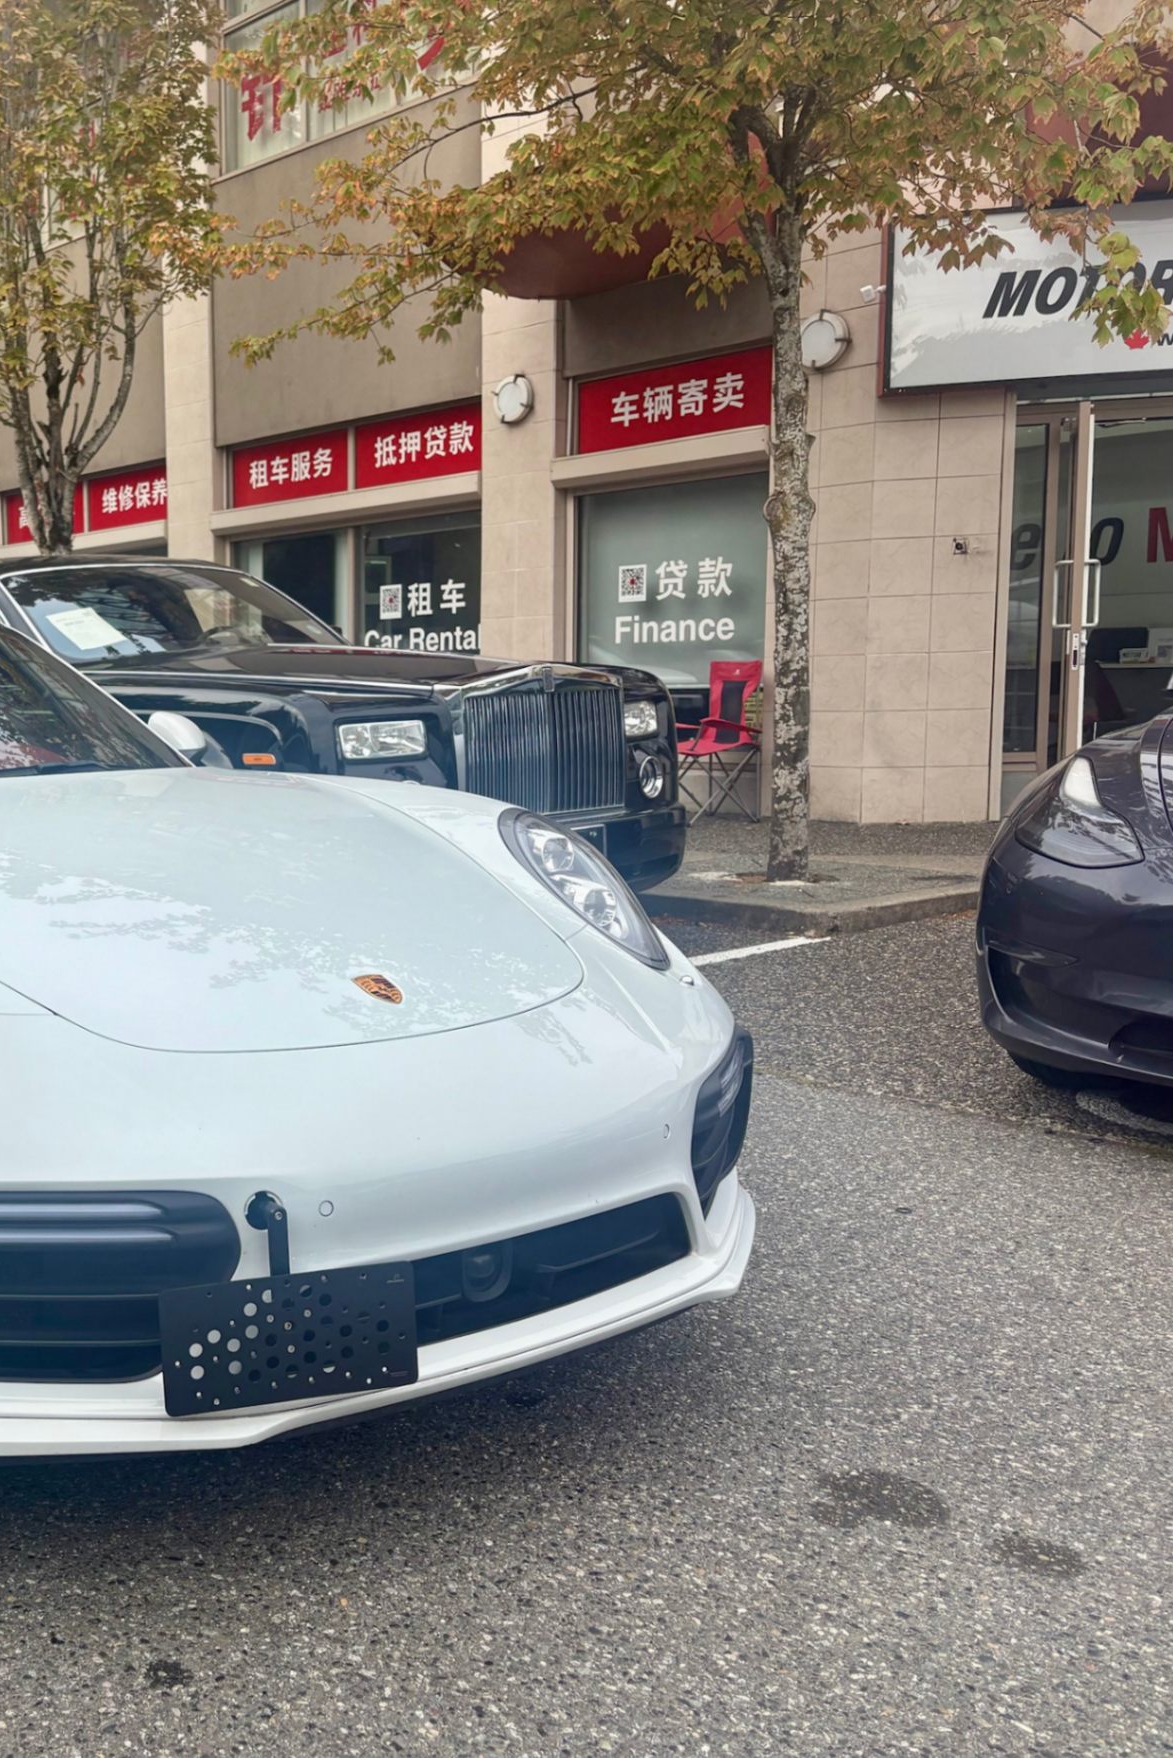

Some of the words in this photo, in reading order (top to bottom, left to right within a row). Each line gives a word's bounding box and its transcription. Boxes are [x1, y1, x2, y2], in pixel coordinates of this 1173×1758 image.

[610, 372, 745, 428] 车辆寄卖
[374, 420, 474, 469] 抵押贷款
[249, 447, 334, 490] 租车服务
[101, 477, 168, 514] 维修保养
[407, 579, 466, 617] 租车
[655, 556, 733, 601] 贷款
[364, 629, 402, 649] Car
[409, 623, 482, 652] Rental
[614, 615, 735, 644] Finance
